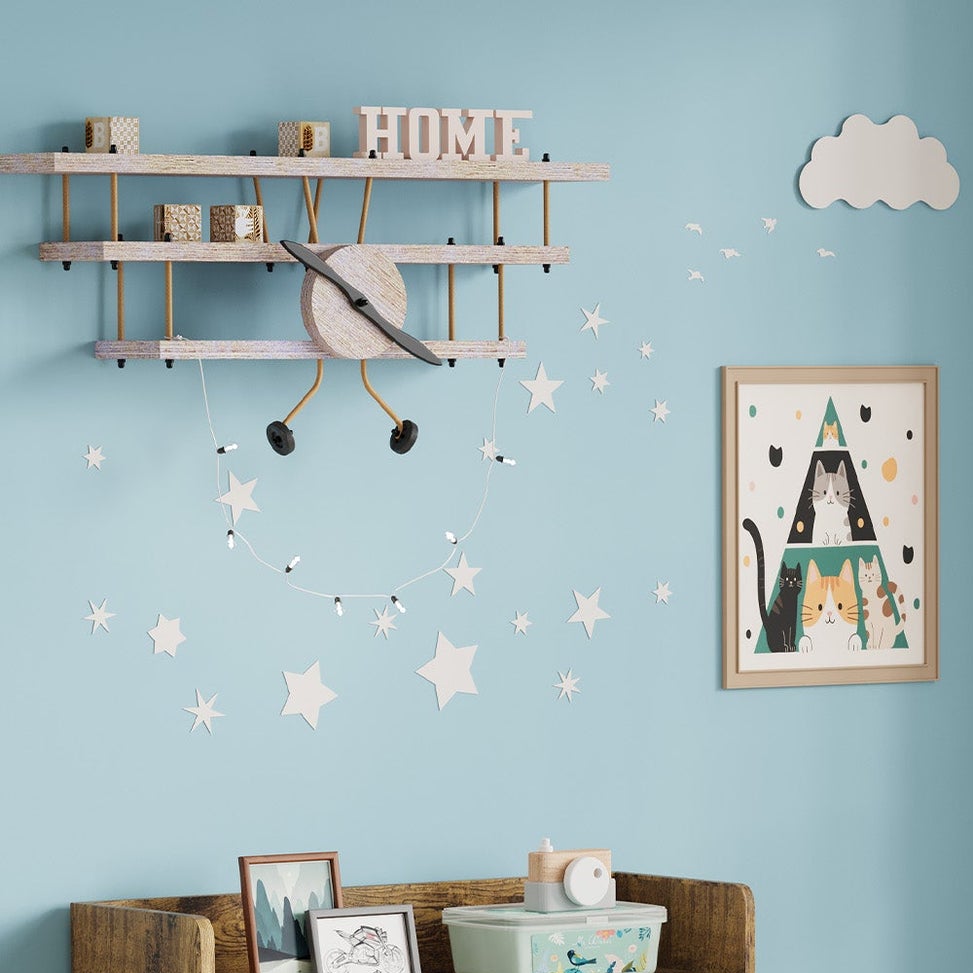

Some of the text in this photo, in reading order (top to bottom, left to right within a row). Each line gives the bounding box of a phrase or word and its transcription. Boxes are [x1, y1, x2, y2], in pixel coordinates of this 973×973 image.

[93, 122, 104, 147] B
[314, 126, 328, 152] B
[354, 106, 533, 161] HOME
